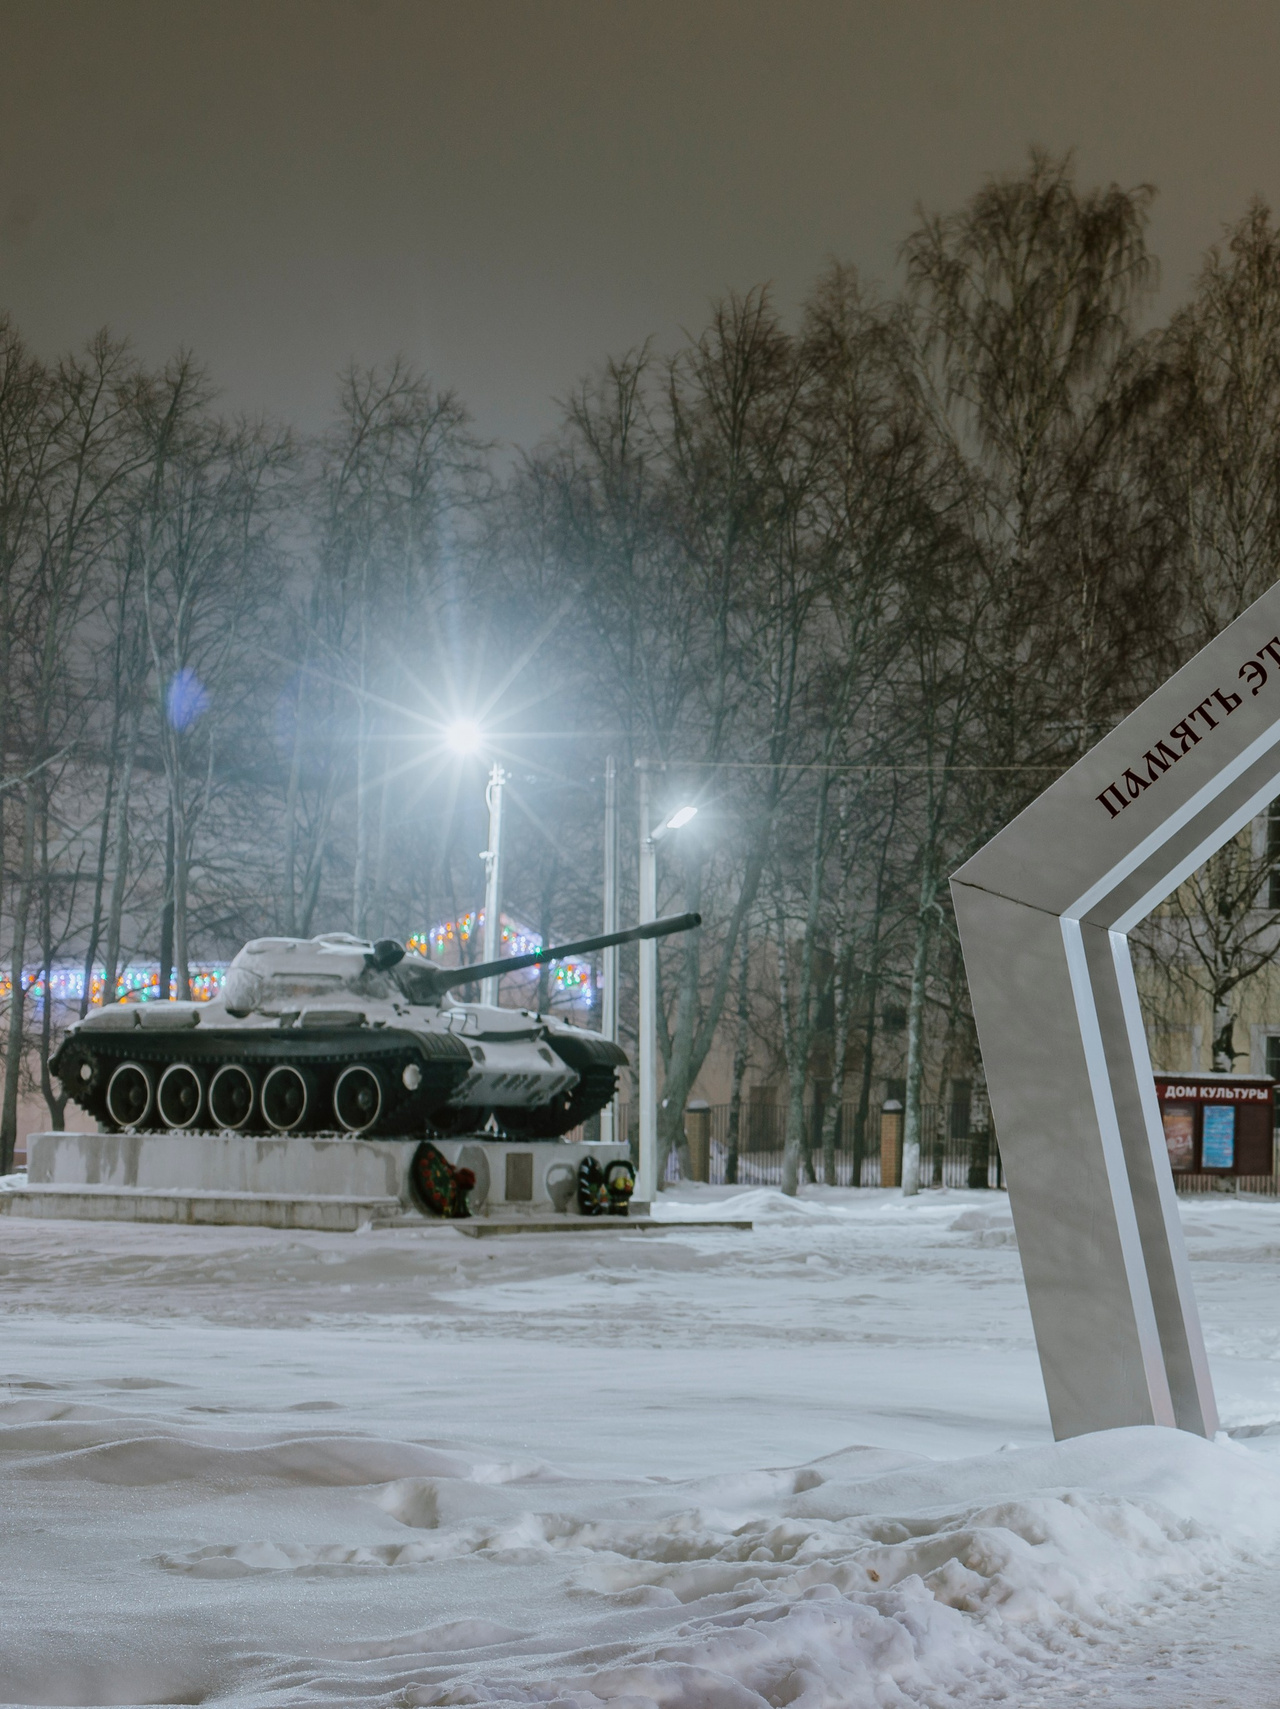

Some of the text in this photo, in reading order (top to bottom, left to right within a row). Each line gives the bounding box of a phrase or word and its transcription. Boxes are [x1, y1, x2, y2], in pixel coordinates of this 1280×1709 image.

[1094, 687, 1243, 820] ПАМЯТЬ
[1165, 1085, 1269, 1100] ДОМ КУЛЬТУРЫ
